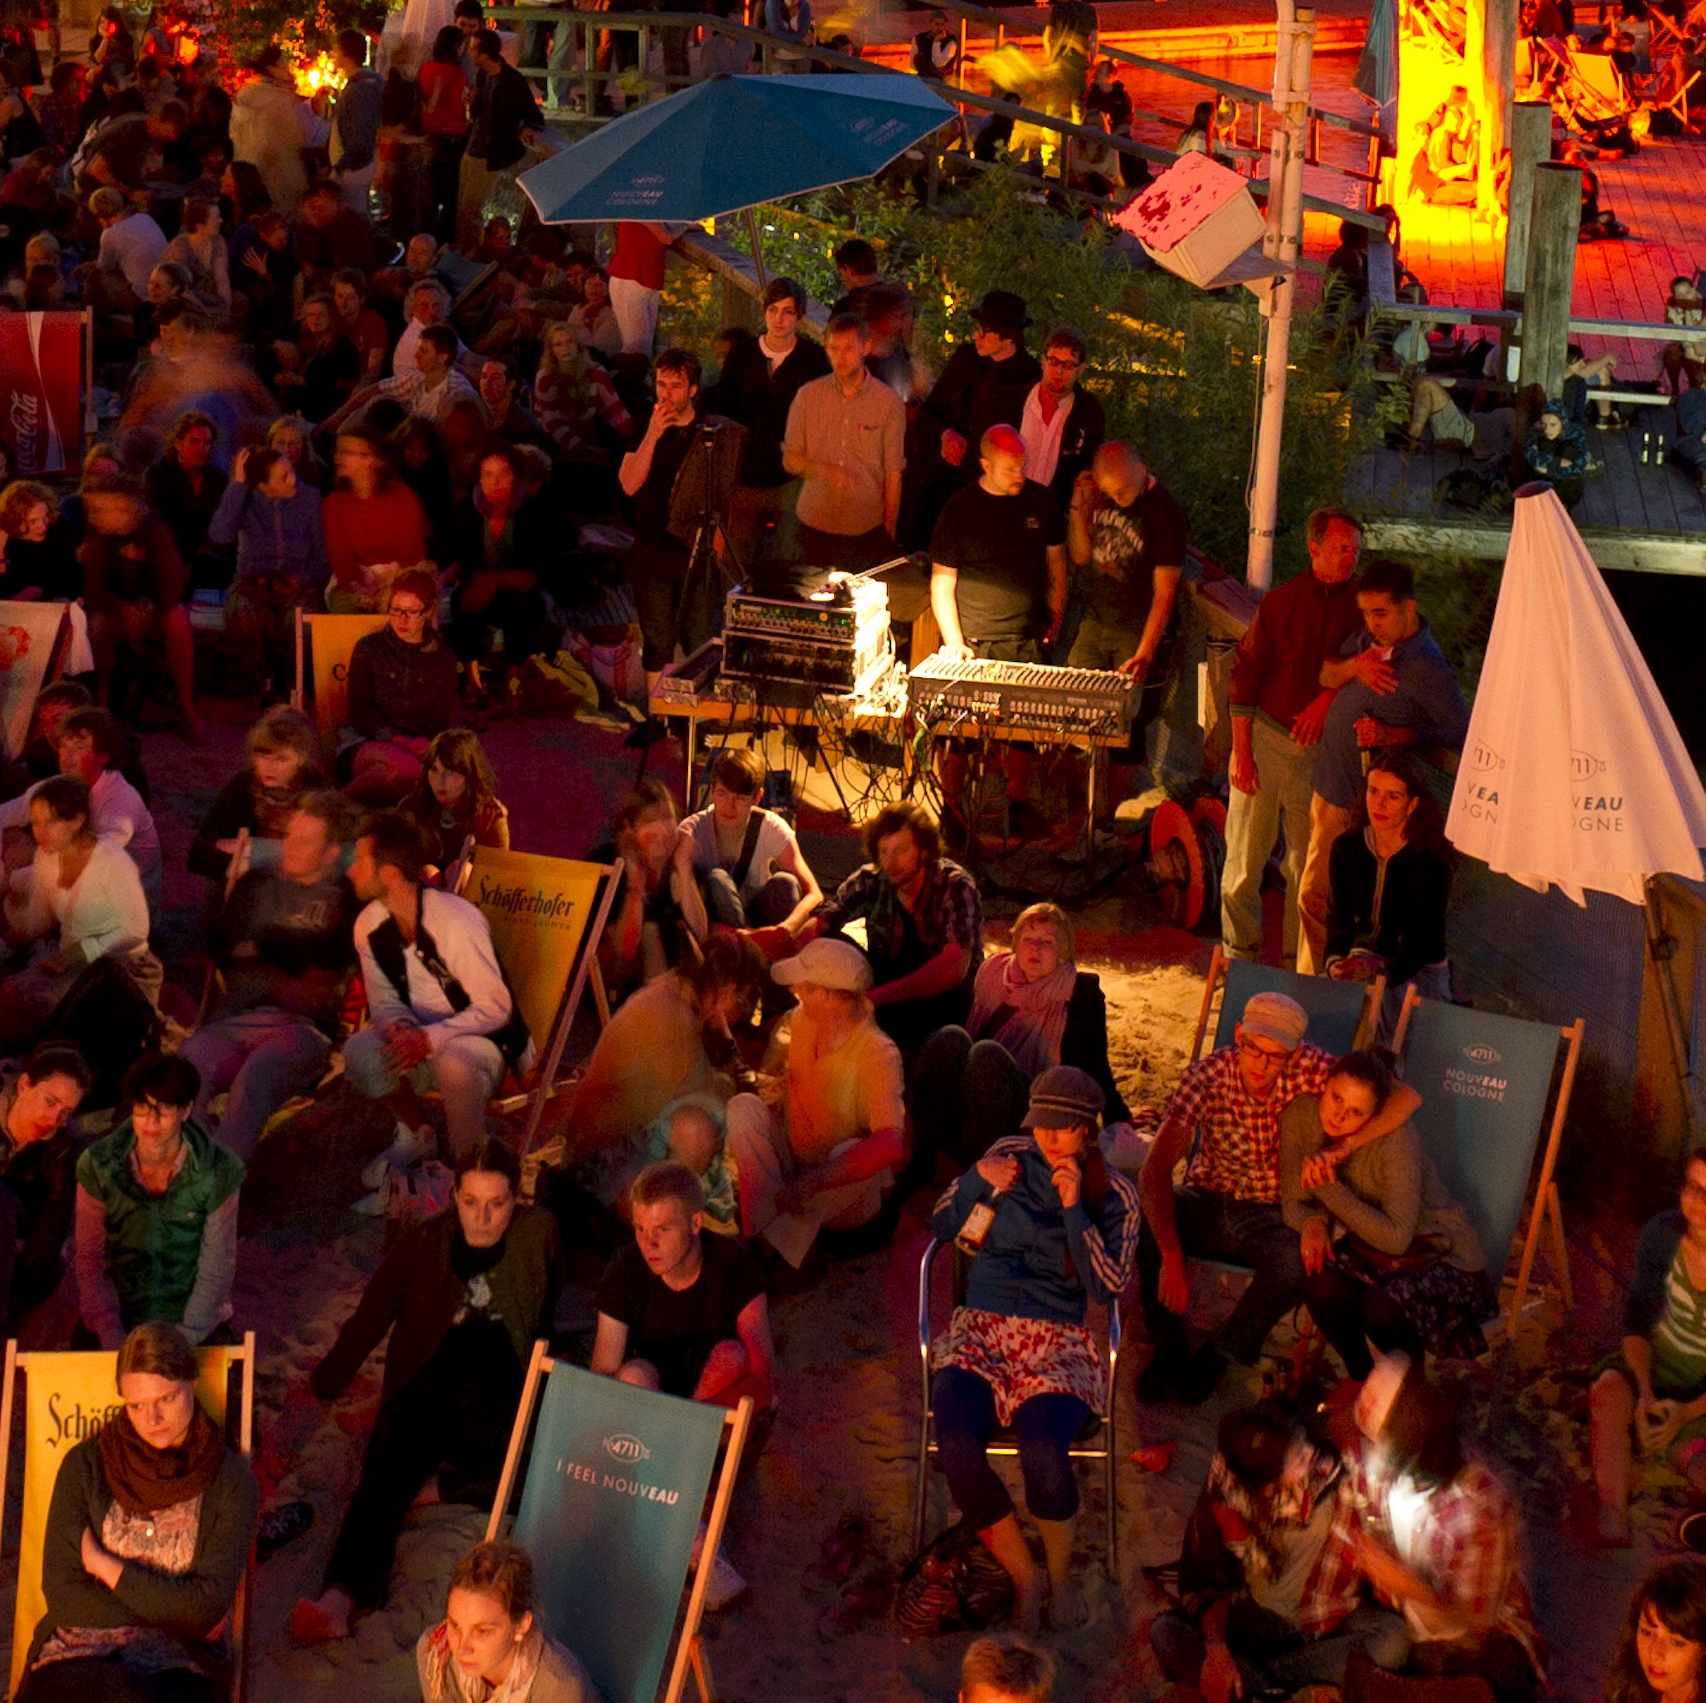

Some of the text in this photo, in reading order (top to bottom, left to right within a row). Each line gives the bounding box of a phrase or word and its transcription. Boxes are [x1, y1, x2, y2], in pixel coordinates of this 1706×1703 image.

[473, 874, 575, 917] Schöfferhofer
[1443, 1079, 1506, 1103] COLOGNE
[1445, 1068, 1508, 1090] NOUVEAU
[556, 1458, 680, 1505] I FEEL NOUVEAU
